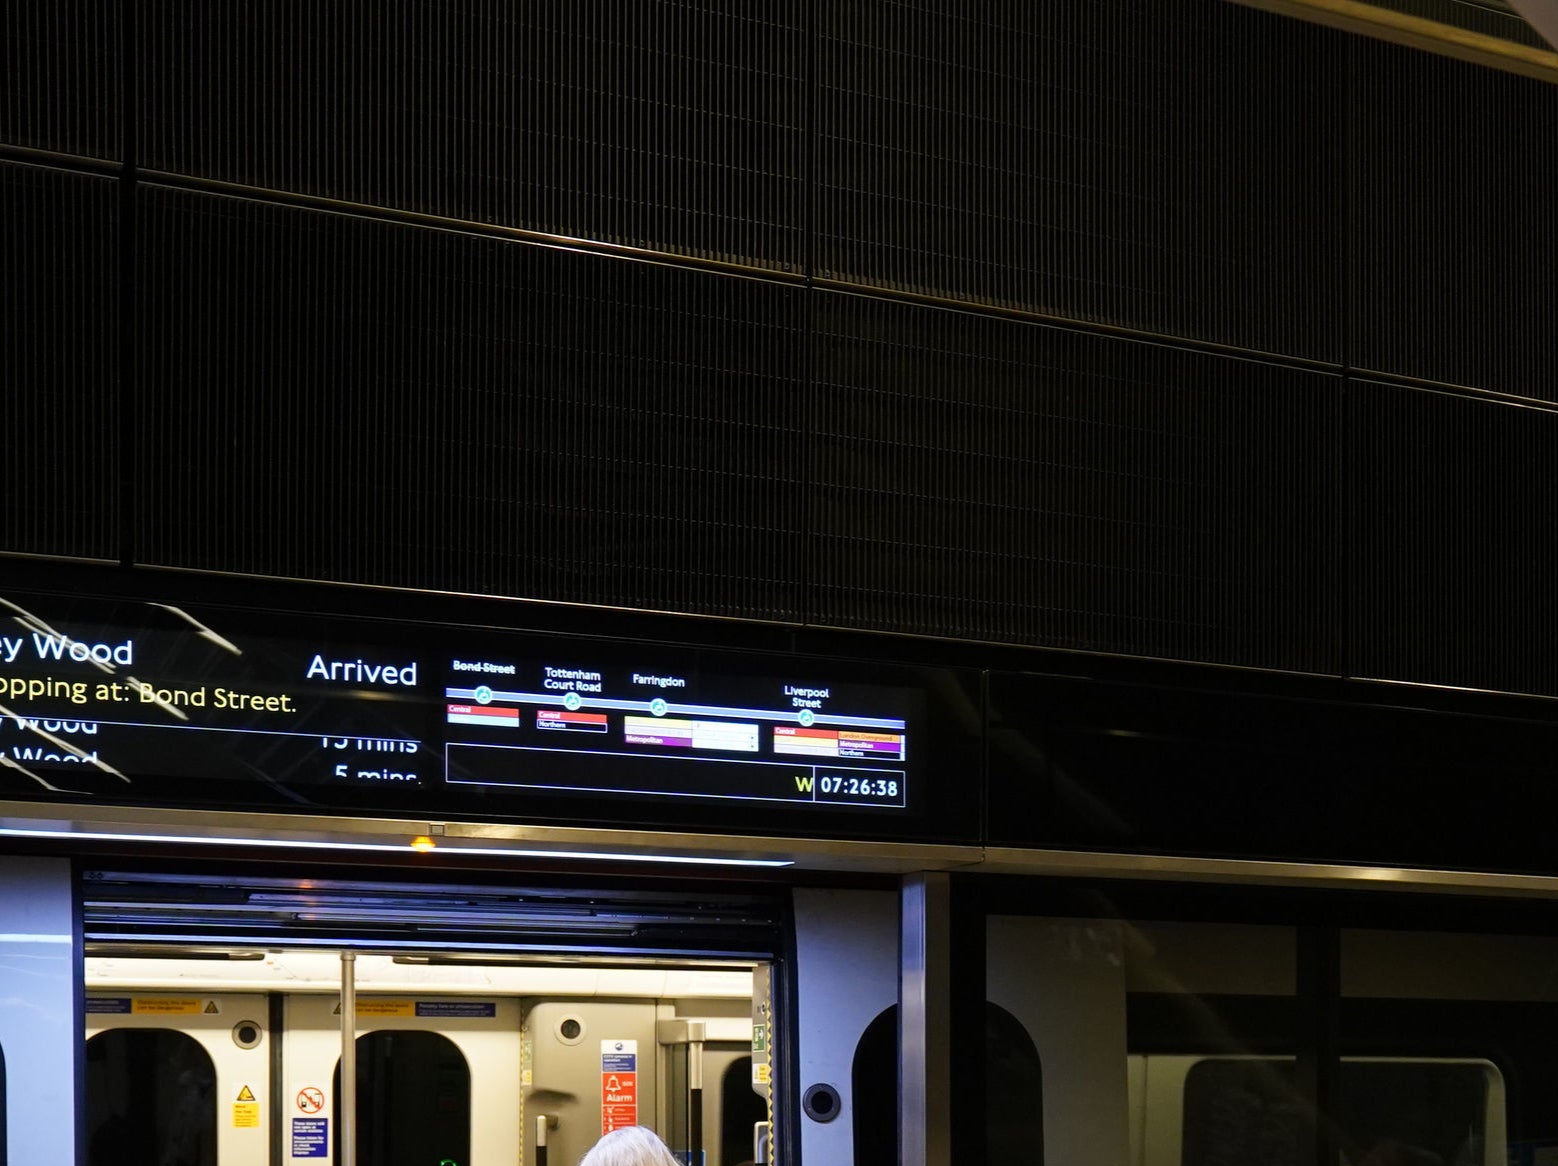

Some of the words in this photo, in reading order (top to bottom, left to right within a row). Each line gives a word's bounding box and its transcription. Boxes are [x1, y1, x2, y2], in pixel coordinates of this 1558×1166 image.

[33, 633, 132, 664] Wood
[307, 654, 416, 686] Arrived
[453, 660, 481, 673] Bond
[483, 663, 516, 675] Street
[545, 667, 601, 681] Tottenham
[544, 679, 573, 691] Court
[576, 681, 602, 692] Road
[632, 673, 685, 688] Farringdon
[96, 682, 129, 702] at:
[139, 682, 205, 707] Bond
[214, 688, 297, 712] Street.
[784, 685, 829, 698] Liverpool
[792, 697, 822, 708] Street
[449, 705, 471, 714] Central
[539, 711, 560, 720] Central
[539, 721, 566, 729] Northern
[626, 734, 663, 744] Metropolitan
[820, 776, 898, 796] 07:26:38
[606, 1094, 633, 1102] Alarm
